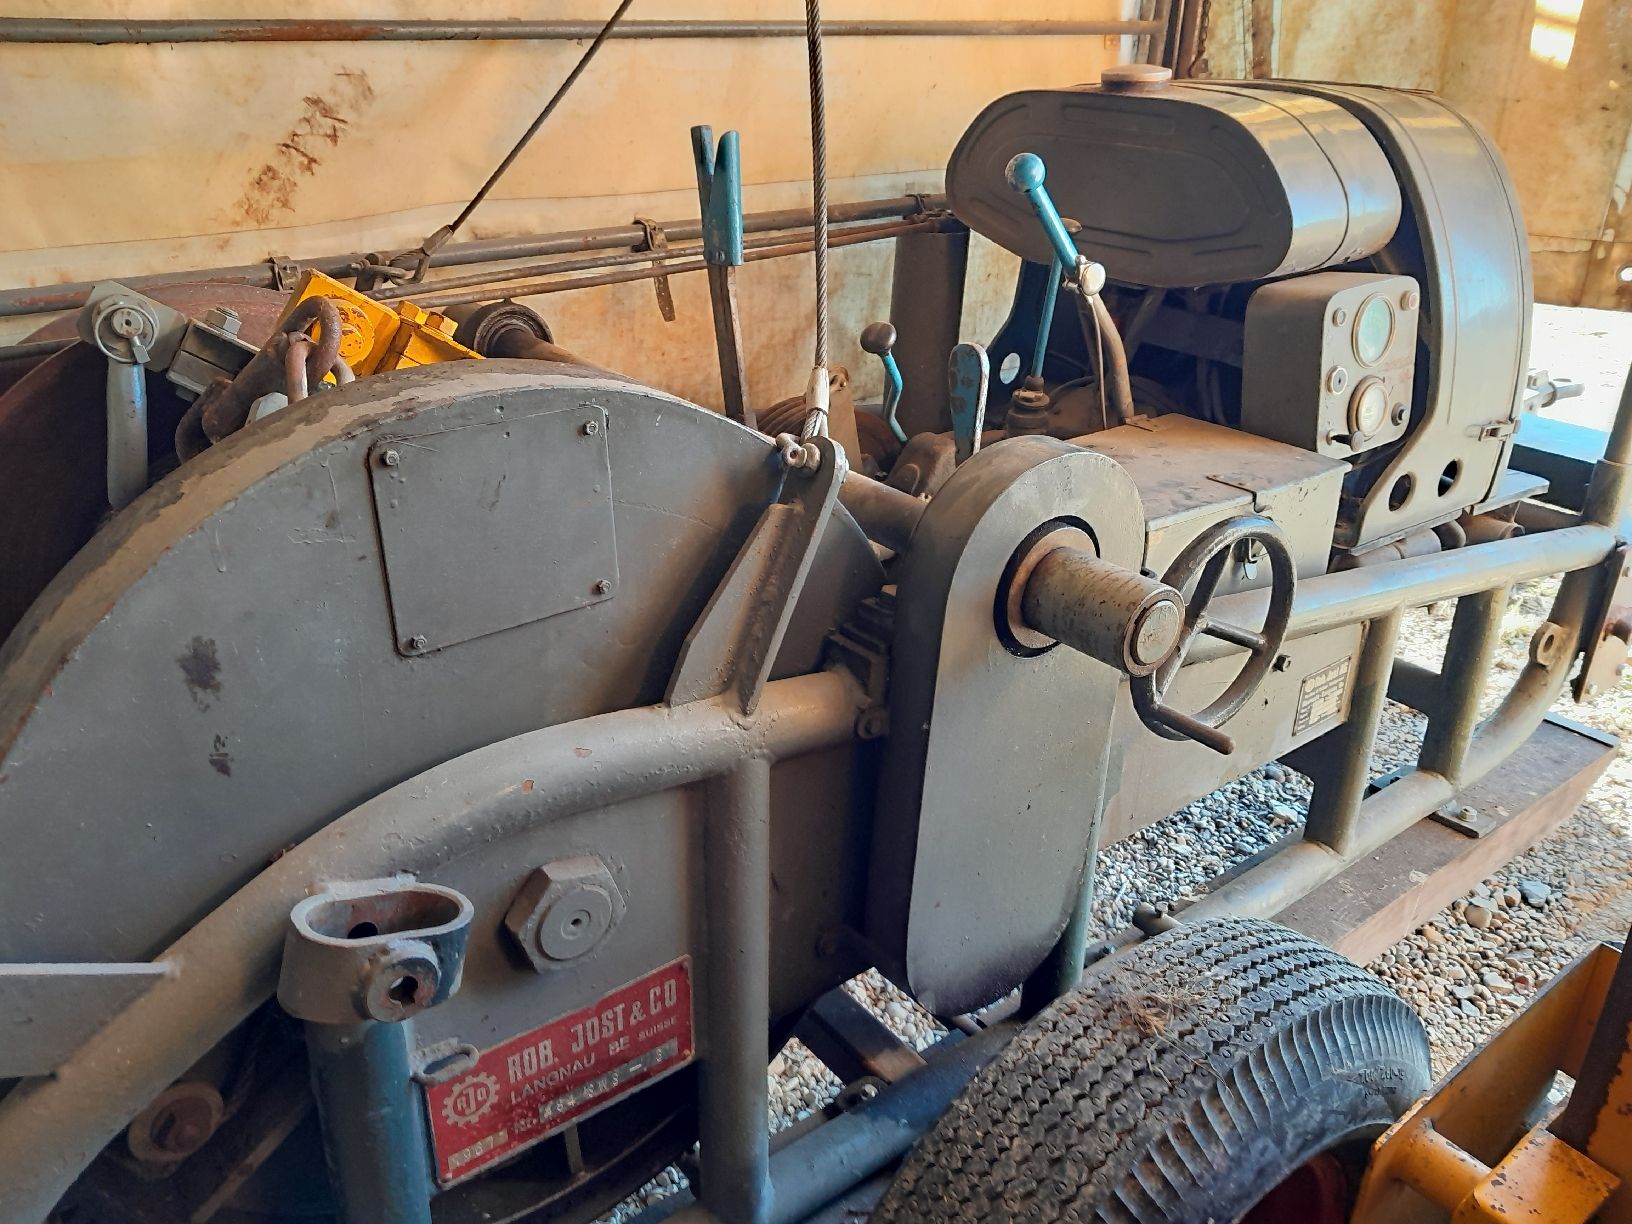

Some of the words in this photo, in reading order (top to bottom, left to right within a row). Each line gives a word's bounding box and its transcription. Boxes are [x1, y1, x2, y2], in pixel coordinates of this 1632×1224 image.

[507, 1038, 560, 1084] ROB.
[570, 1003, 625, 1053] JOST
[629, 1003, 646, 1026] &
[649, 979, 677, 1014] CO
